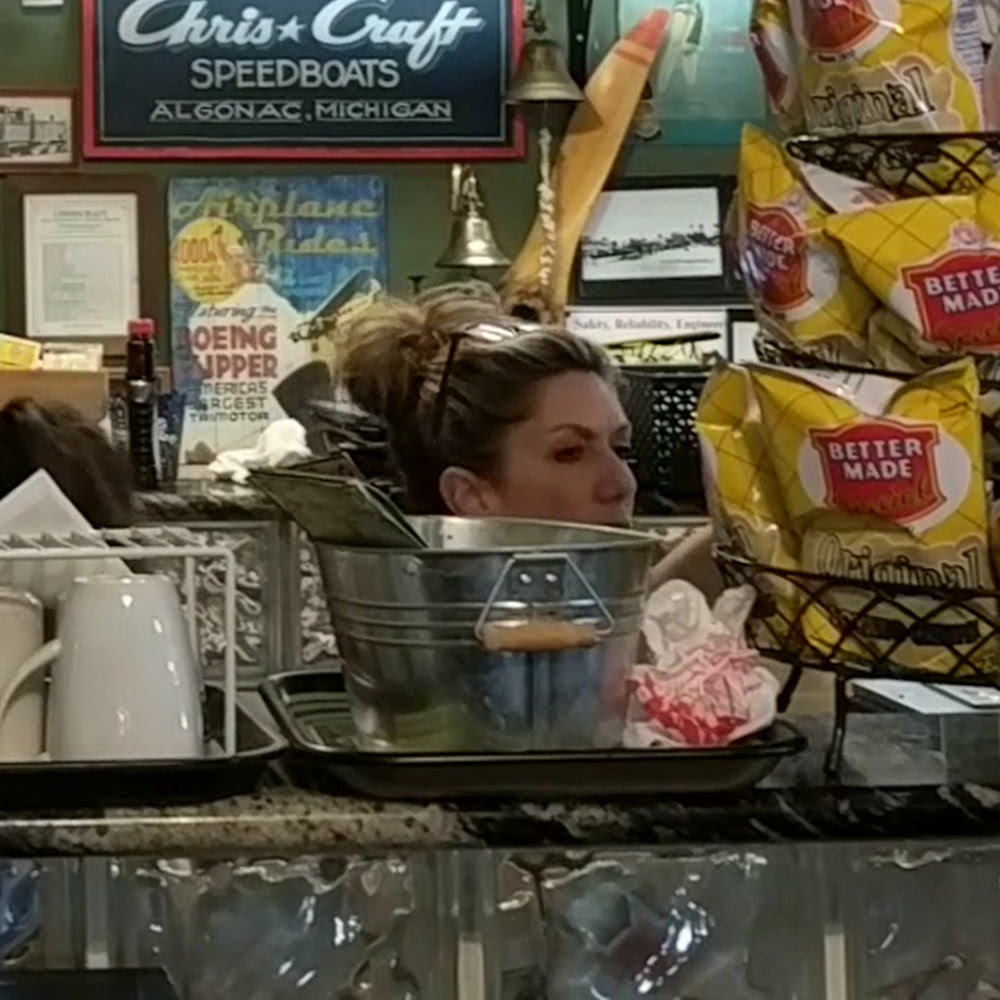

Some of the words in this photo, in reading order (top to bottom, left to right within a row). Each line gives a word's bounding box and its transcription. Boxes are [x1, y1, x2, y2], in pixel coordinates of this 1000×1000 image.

[190, 57, 400, 90] SPEEDBOATS
[315, 100, 453, 121] MICHIGAN
[942, 286, 1000, 315] MAD
[827, 437, 924, 461] BETTER
[842, 458, 914, 482] MADE
